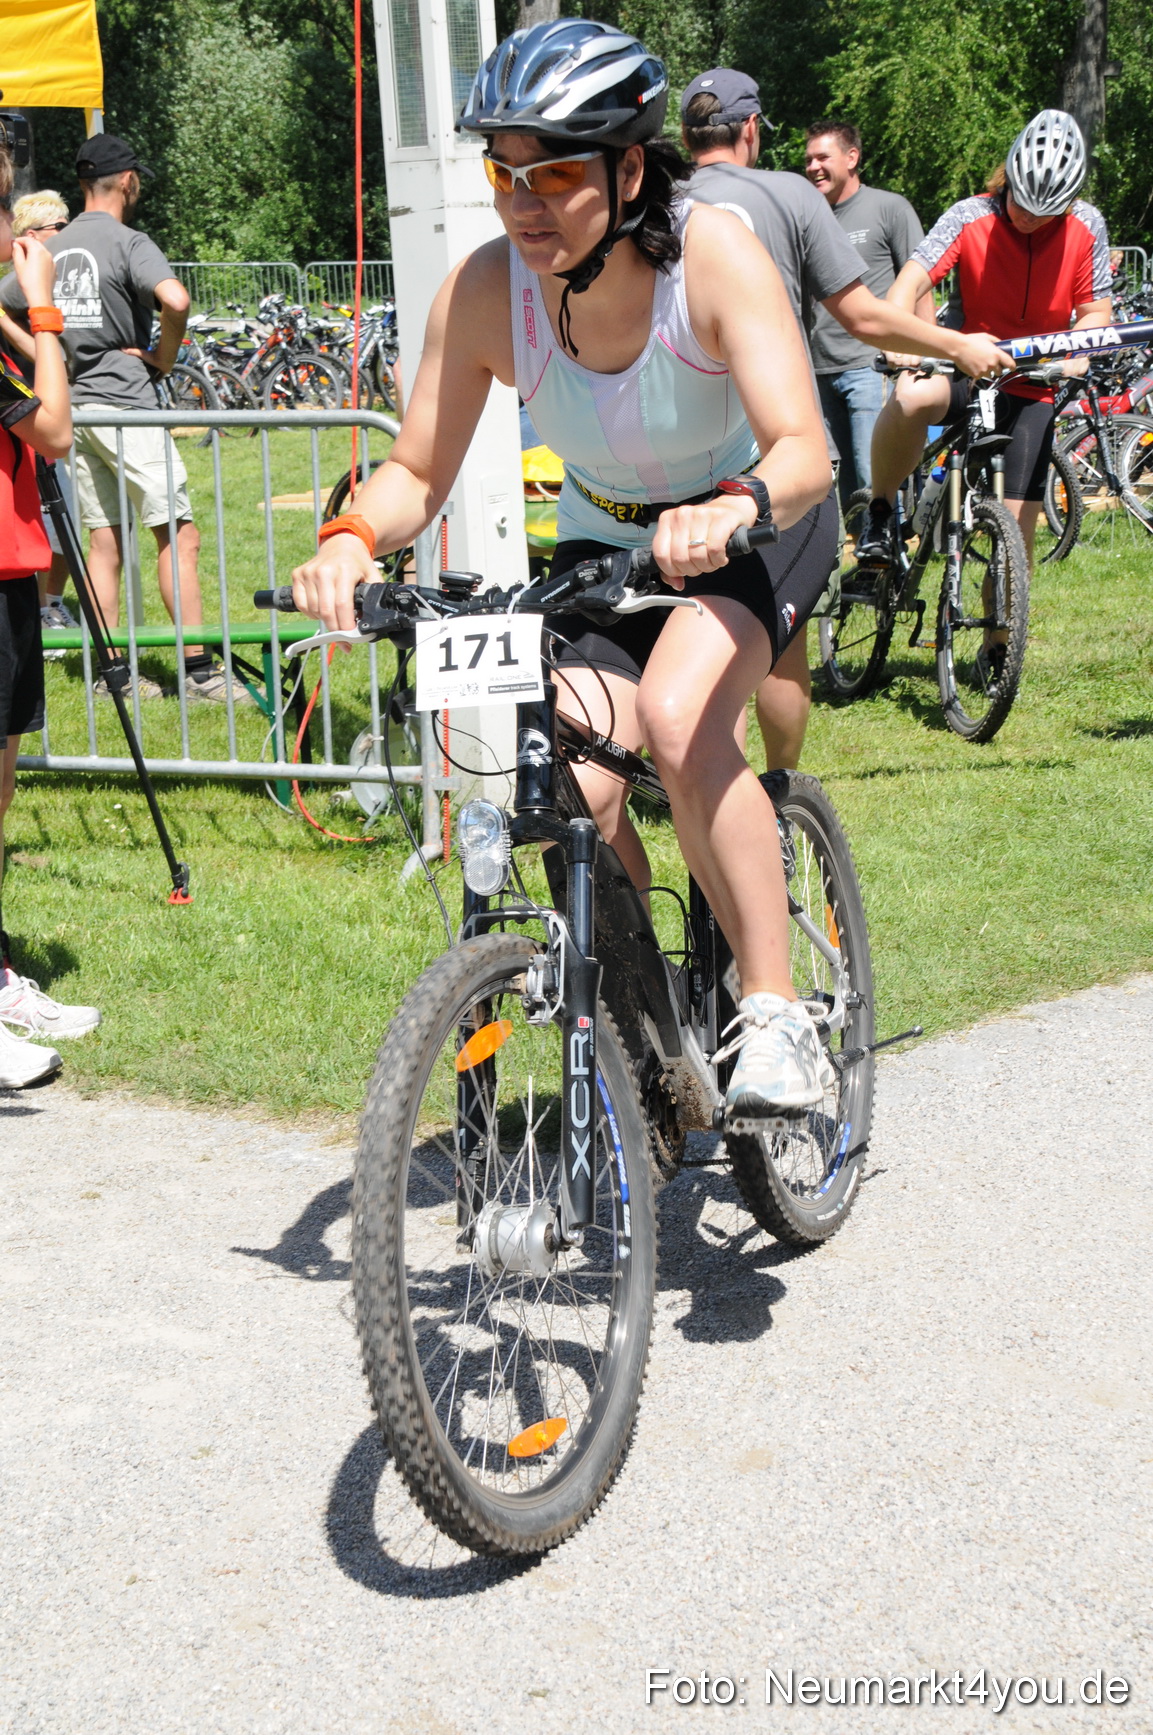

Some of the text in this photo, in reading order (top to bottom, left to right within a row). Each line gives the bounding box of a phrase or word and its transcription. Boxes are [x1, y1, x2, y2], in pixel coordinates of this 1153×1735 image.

[523, 305, 537, 349] SCOTT
[1032, 326, 1123, 354] VARTA
[439, 631, 519, 672] 171
[570, 1031, 591, 1180] XCR
